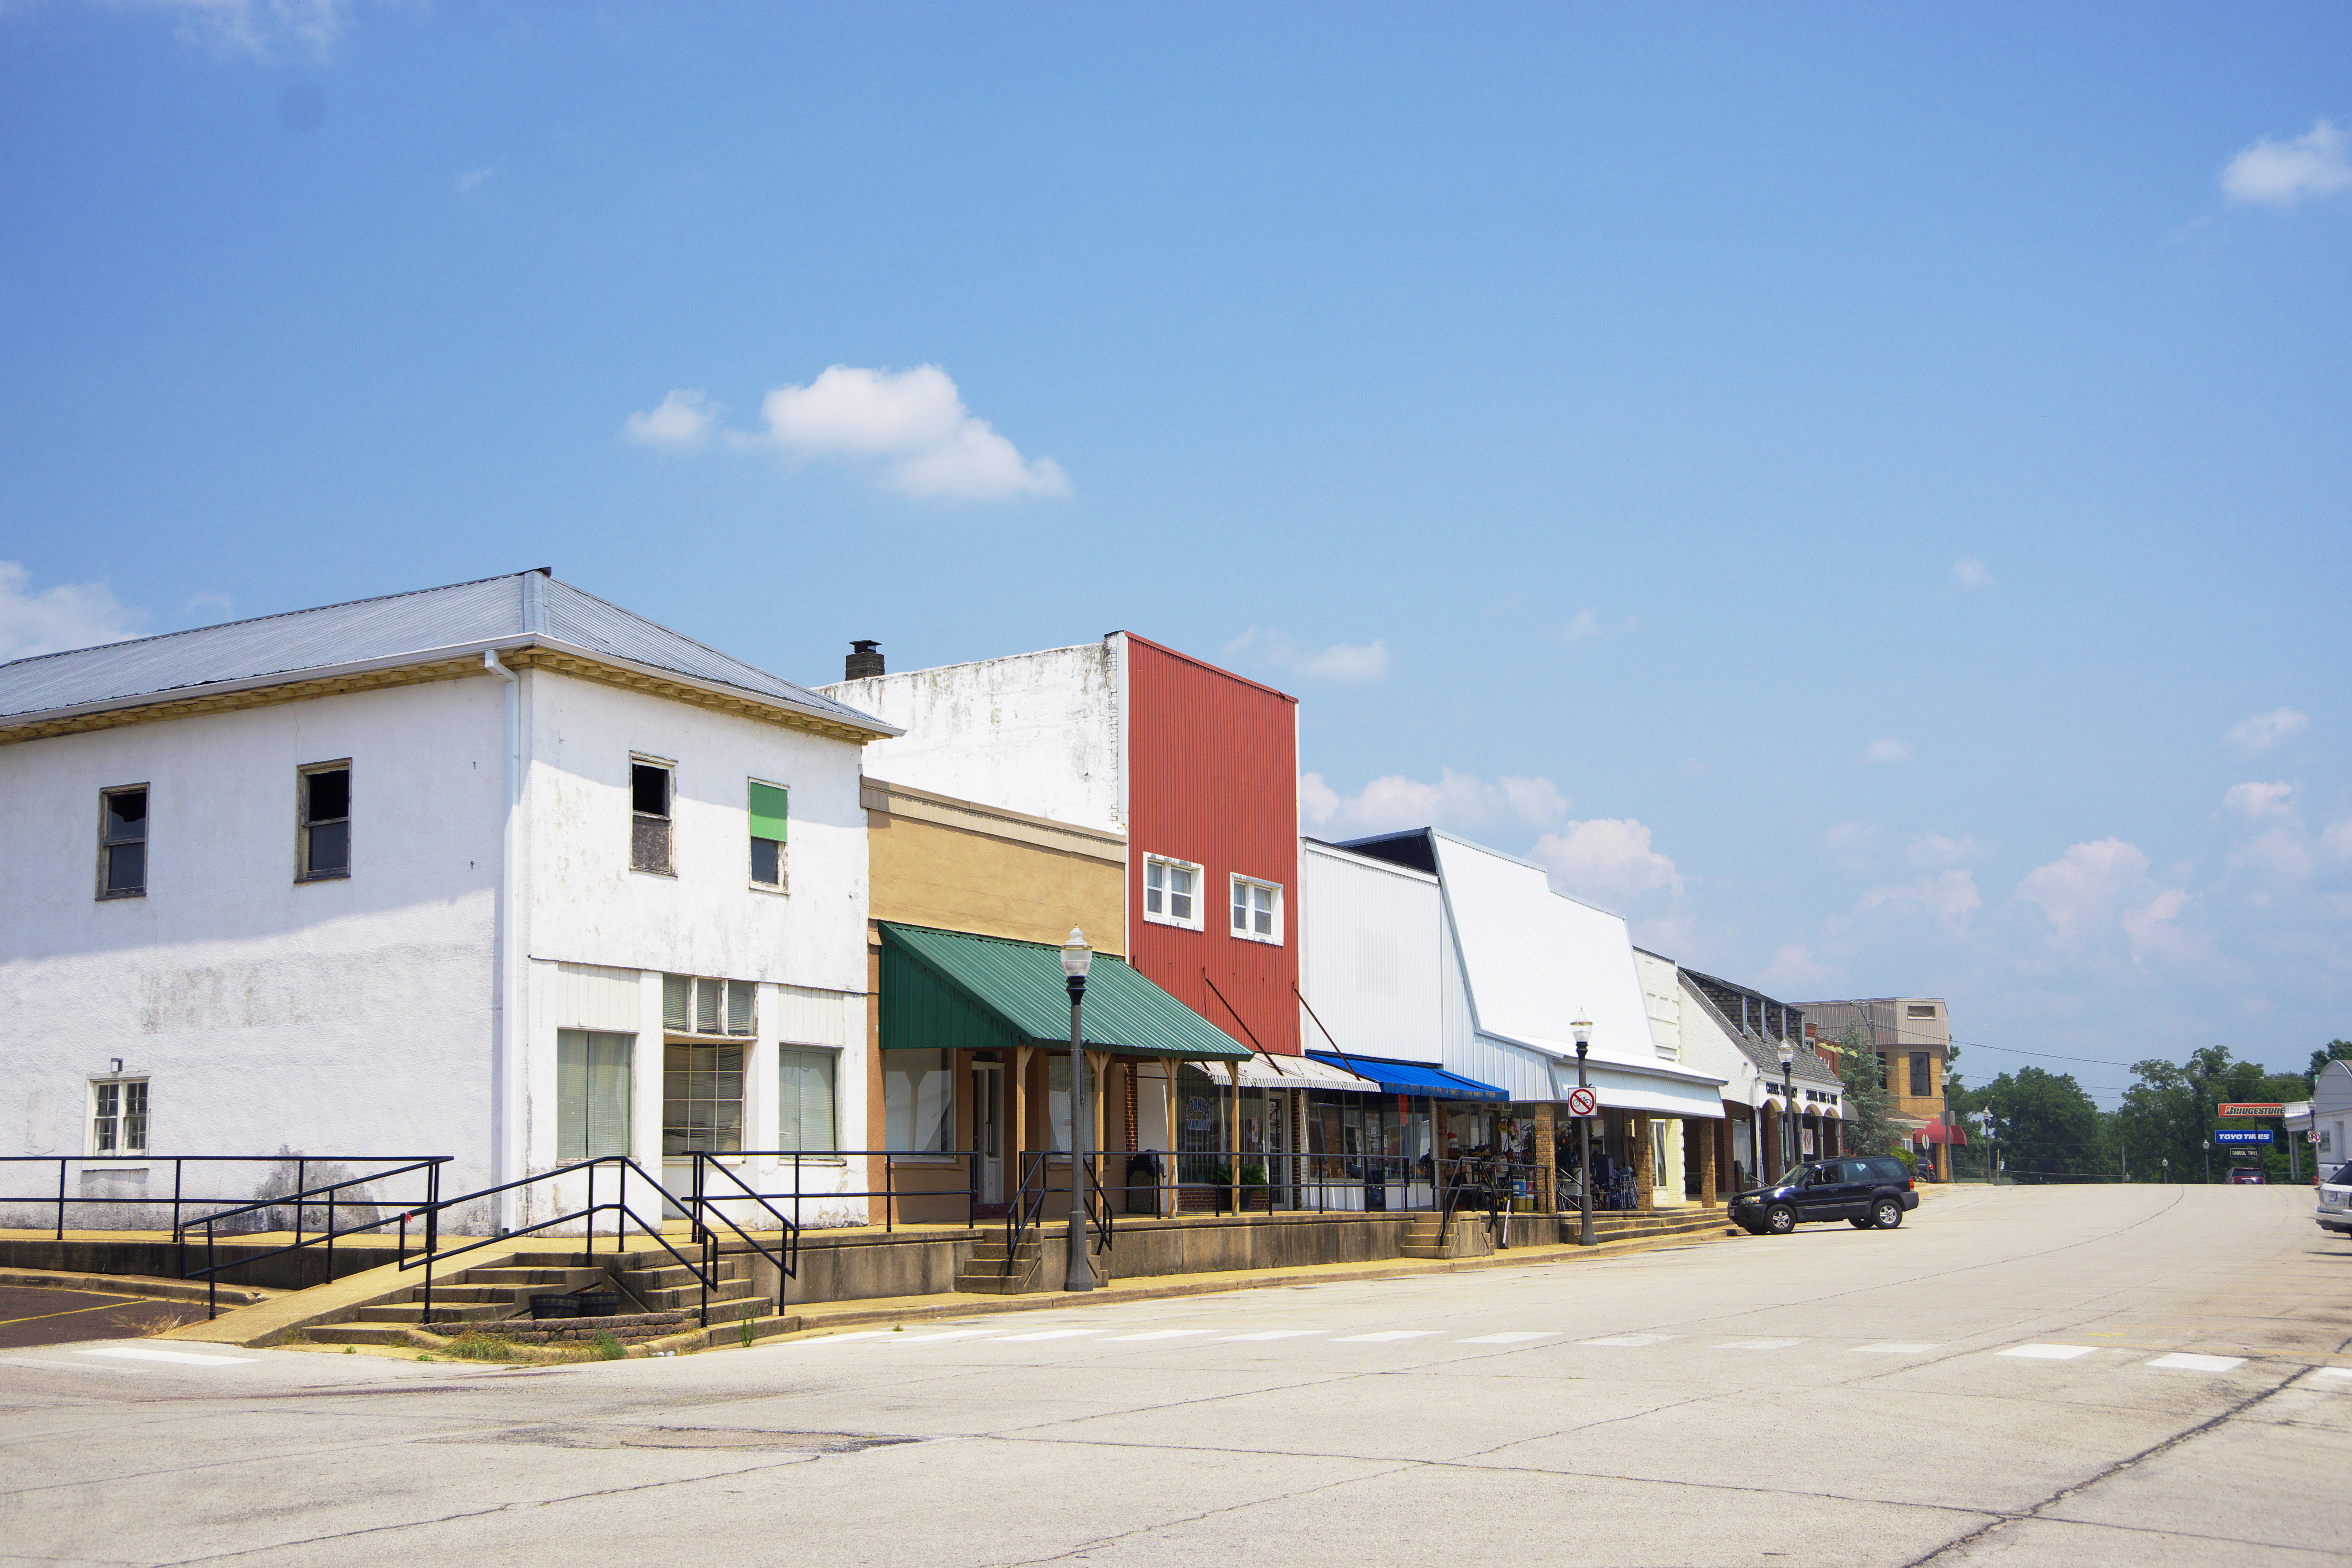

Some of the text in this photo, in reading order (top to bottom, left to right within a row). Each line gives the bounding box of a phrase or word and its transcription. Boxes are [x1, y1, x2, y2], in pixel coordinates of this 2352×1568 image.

[1185, 1096, 1211, 1120] COONTS
[2224, 1105, 2285, 1115] BRIDGESTONE
[1187, 1119, 1211, 1131] VARIETY
